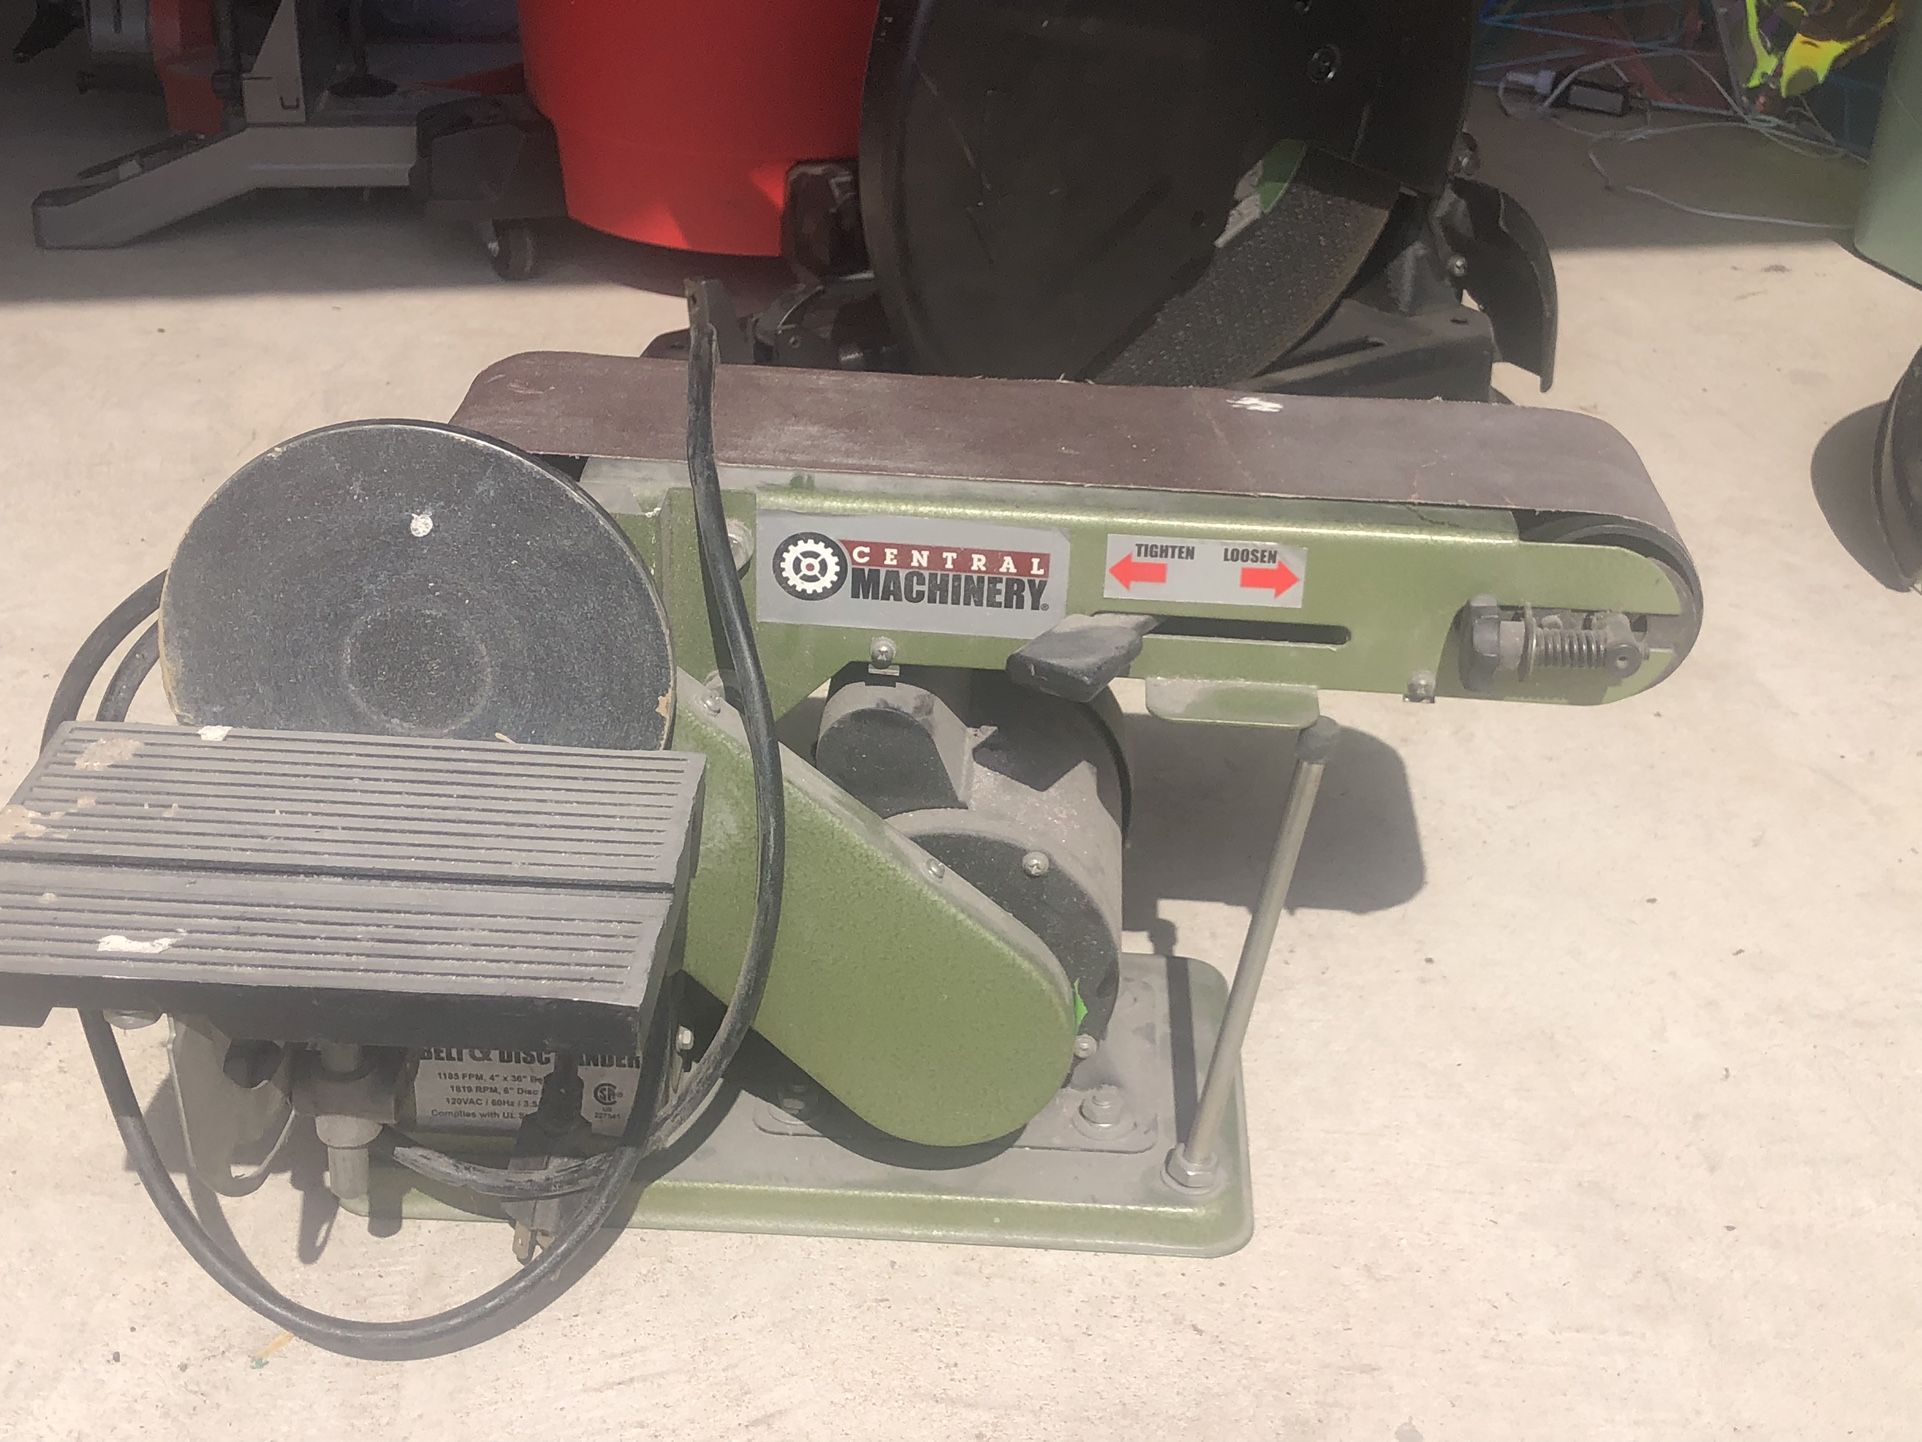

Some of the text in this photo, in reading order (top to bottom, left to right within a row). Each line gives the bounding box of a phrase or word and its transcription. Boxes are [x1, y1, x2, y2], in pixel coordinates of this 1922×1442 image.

[1136, 544, 1195, 560] TIGHTEN
[1223, 548, 1278, 564] LOOSEN
[852, 546, 1045, 576] CENTRAL
[499, 1049, 552, 1066] DISC
[517, 1087, 539, 1096] Disc
[446, 1097, 483, 1106] 120VAC
[491, 1098, 515, 1107] 60Hz
[431, 1109, 477, 1119] Complies
[480, 1111, 500, 1119] with
[502, 1112, 517, 1120] UL
